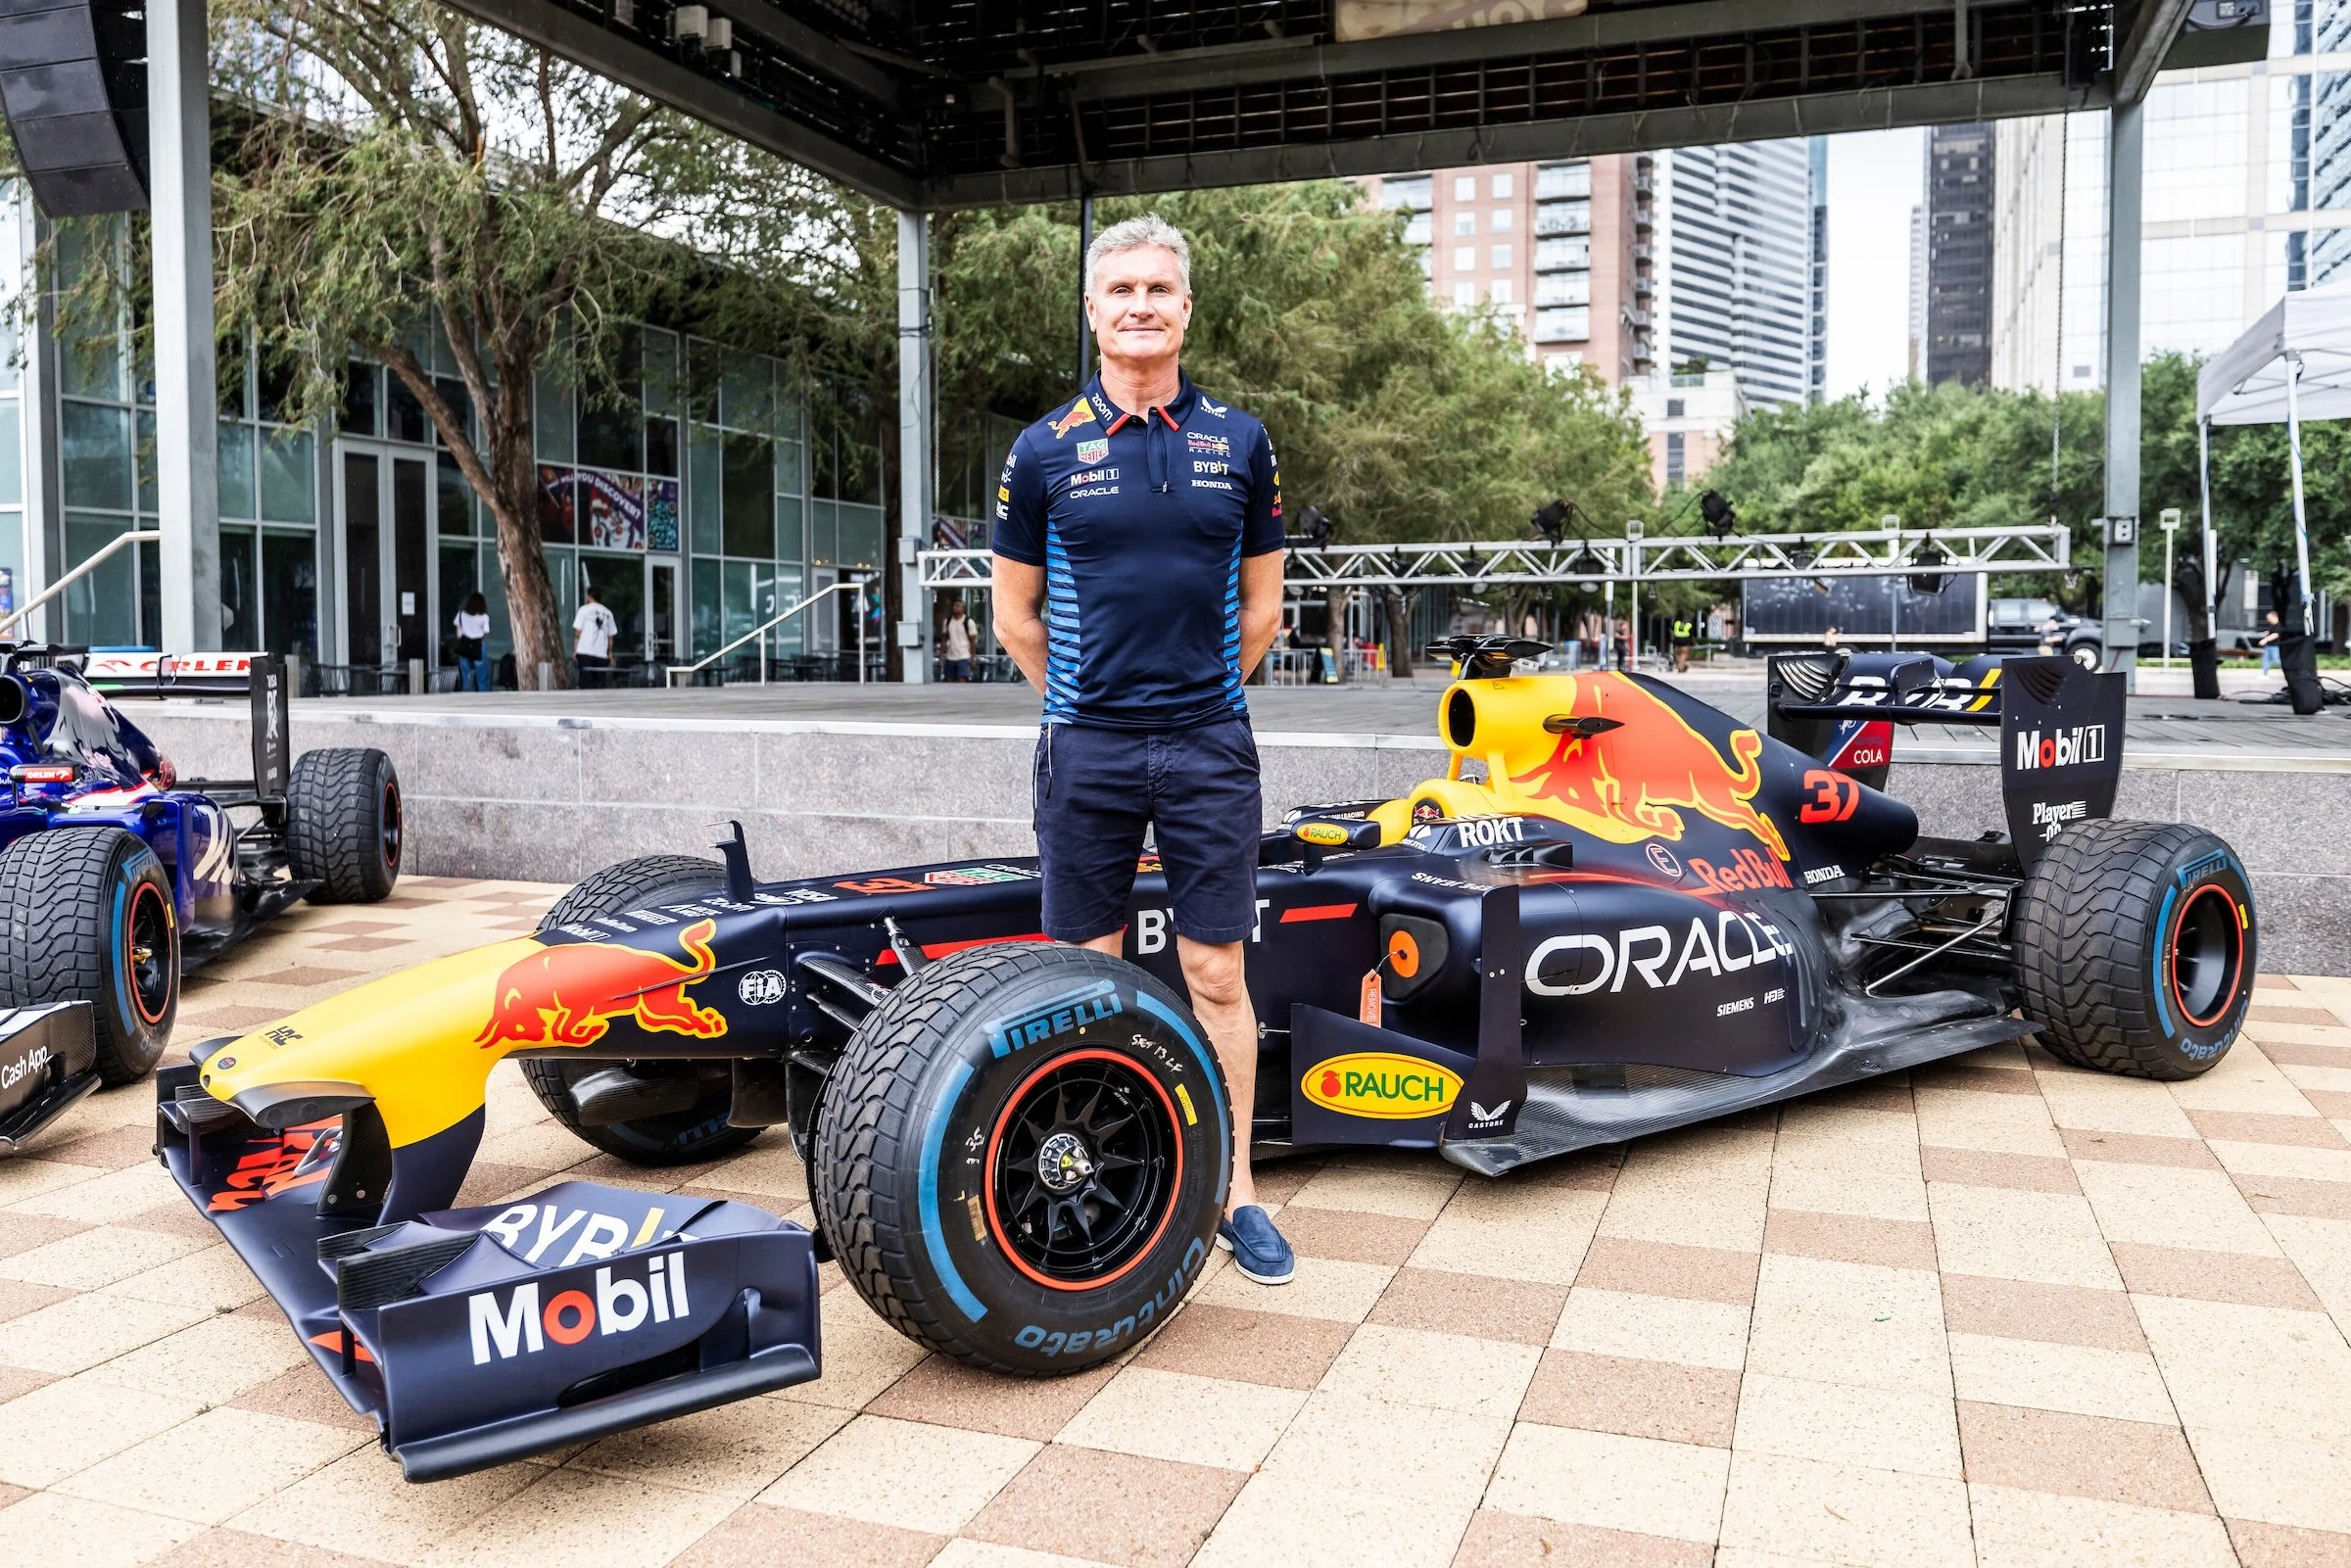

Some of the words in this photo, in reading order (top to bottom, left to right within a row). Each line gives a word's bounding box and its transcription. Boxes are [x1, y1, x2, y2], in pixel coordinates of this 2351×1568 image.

[1092, 393, 1113, 421] zoom
[1081, 441, 1106, 451] TAG
[1186, 431, 1228, 444] ORACLE
[1080, 449, 1107, 463] HEUER
[1071, 470, 1105, 486] Mobil
[1106, 468, 1120, 480] 1
[1193, 460, 1229, 475] BYBIT
[1070, 486, 1120, 499] ORACLE
[1191, 480, 1232, 490] HONDA
[595, 477, 642, 519] DISCOVER?
[1853, 749, 1884, 765] COLA
[2017, 727, 2084, 771] Mobil
[26, 771, 56, 780] ORLEN
[1310, 827, 1342, 840] RAUCH
[1456, 816, 1525, 848] ROKT
[1804, 864, 1846, 884] HONDA
[2176, 848, 2229, 889] PIRELLI
[1412, 872, 1465, 887] JEANS
[1524, 910, 1795, 997] ORACLE
[1367, 988, 1377, 1022] REMOVE
[1716, 997, 1754, 1018] SIEMENS
[983, 979, 1125, 1059] PIRELLI
[1, 1055, 27, 1089] Cash
[27, 1044, 48, 1070] App
[1345, 1071, 1444, 1103] RAUCH
[1468, 1119, 1505, 1129] CASTORE
[468, 1251, 691, 1366] Mobil
